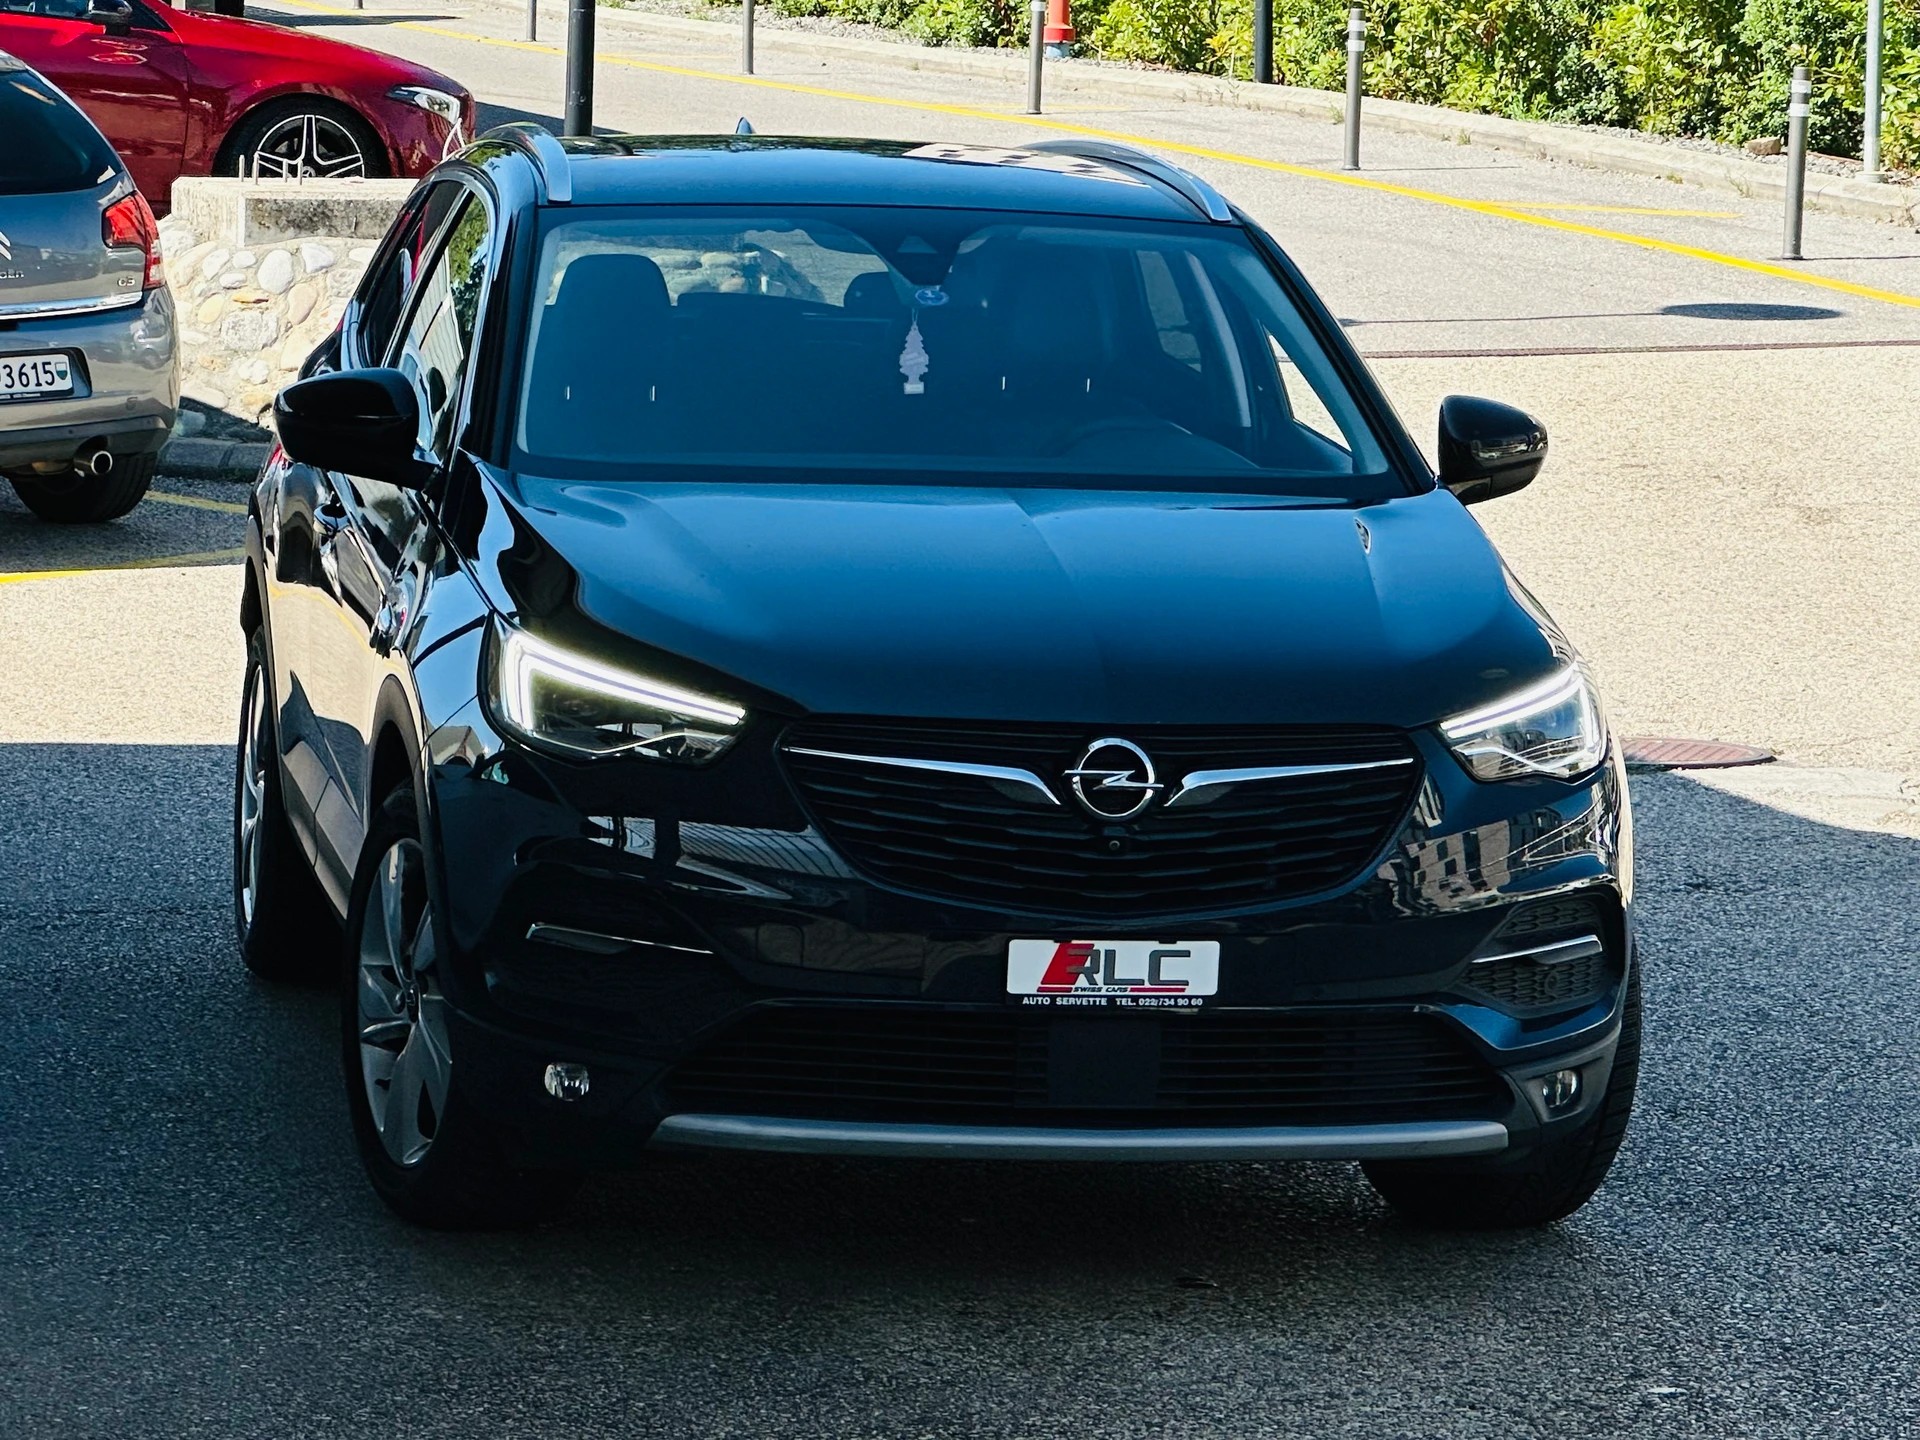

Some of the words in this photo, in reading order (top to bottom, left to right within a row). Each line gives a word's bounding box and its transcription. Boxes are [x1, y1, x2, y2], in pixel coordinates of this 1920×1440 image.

[117, 276, 136, 287] C3
[0, 361, 55, 389] 3615
[1022, 996, 1051, 1005] AUTO
[1055, 997, 1108, 1006] SERVETTE
[1115, 997, 1137, 1006] TEL.
[1177, 998, 1189, 1006] 90
[1190, 998, 1204, 1006] 60
